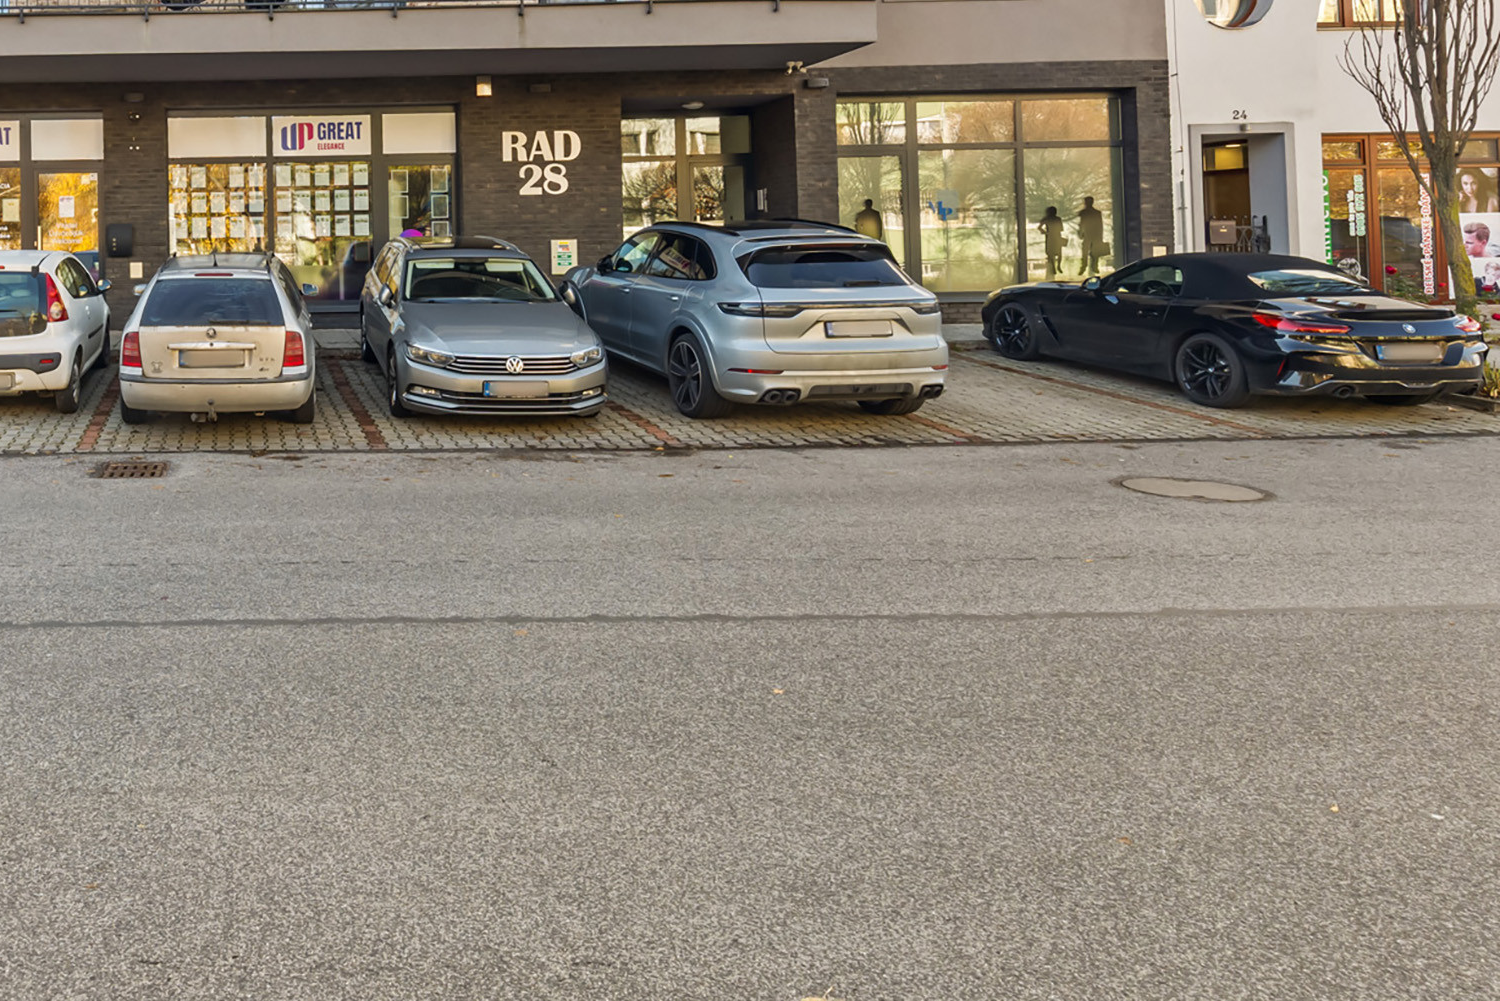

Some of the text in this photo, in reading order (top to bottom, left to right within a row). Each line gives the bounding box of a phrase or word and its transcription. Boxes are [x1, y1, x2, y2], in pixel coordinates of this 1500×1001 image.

[1232, 109, 1248, 120] 24
[317, 122, 362, 140] GREAT
[317, 142, 345, 151] ELEGANCE
[502, 130, 582, 162] RAD
[519, 163, 569, 196] 28
